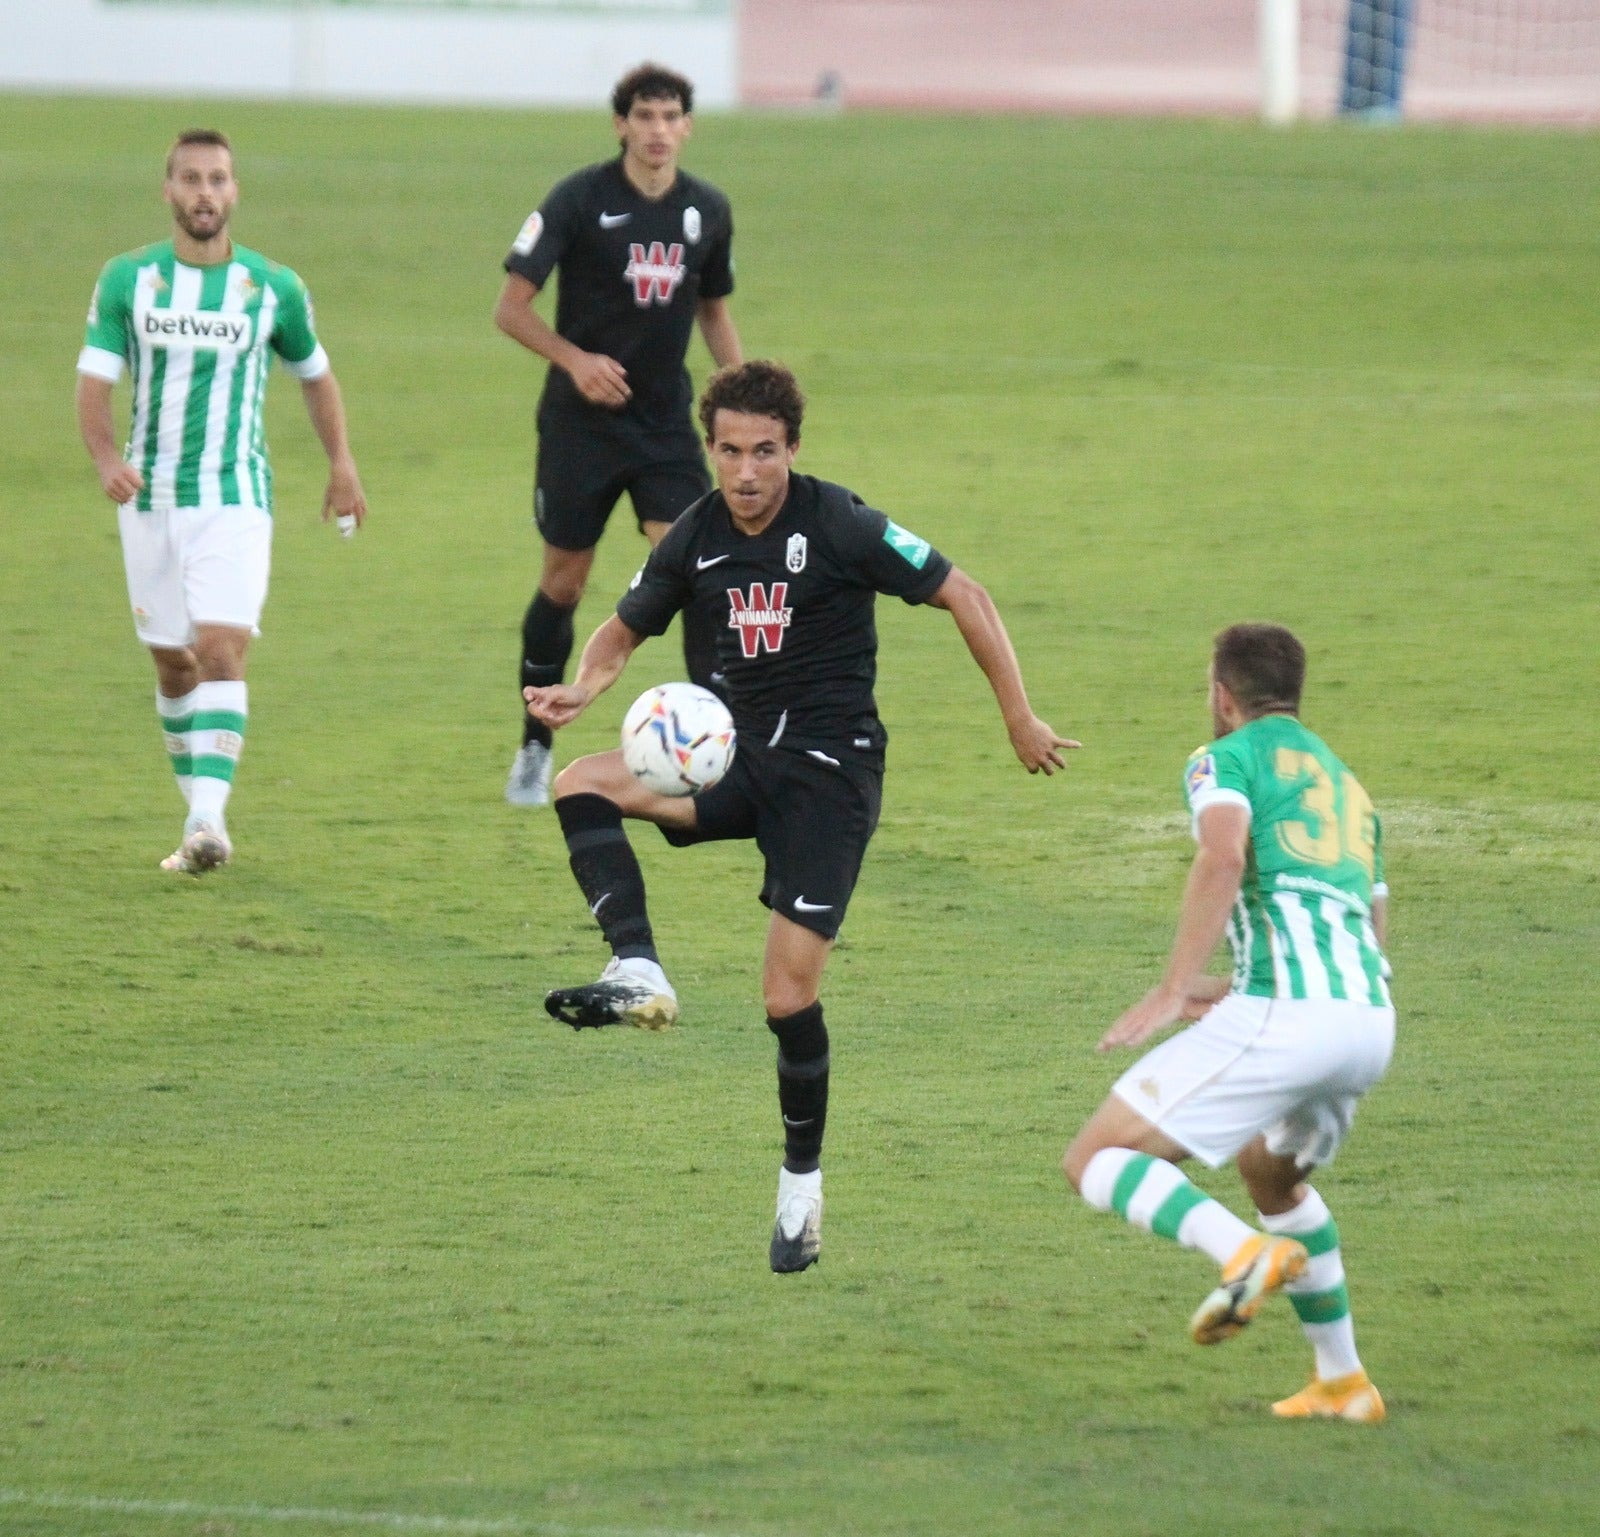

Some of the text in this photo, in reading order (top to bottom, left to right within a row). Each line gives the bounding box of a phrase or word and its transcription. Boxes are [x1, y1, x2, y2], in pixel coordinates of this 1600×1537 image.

[144, 312, 245, 343] betway
[726, 582, 789, 657] W
[735, 609, 786, 626] WINAMAX
